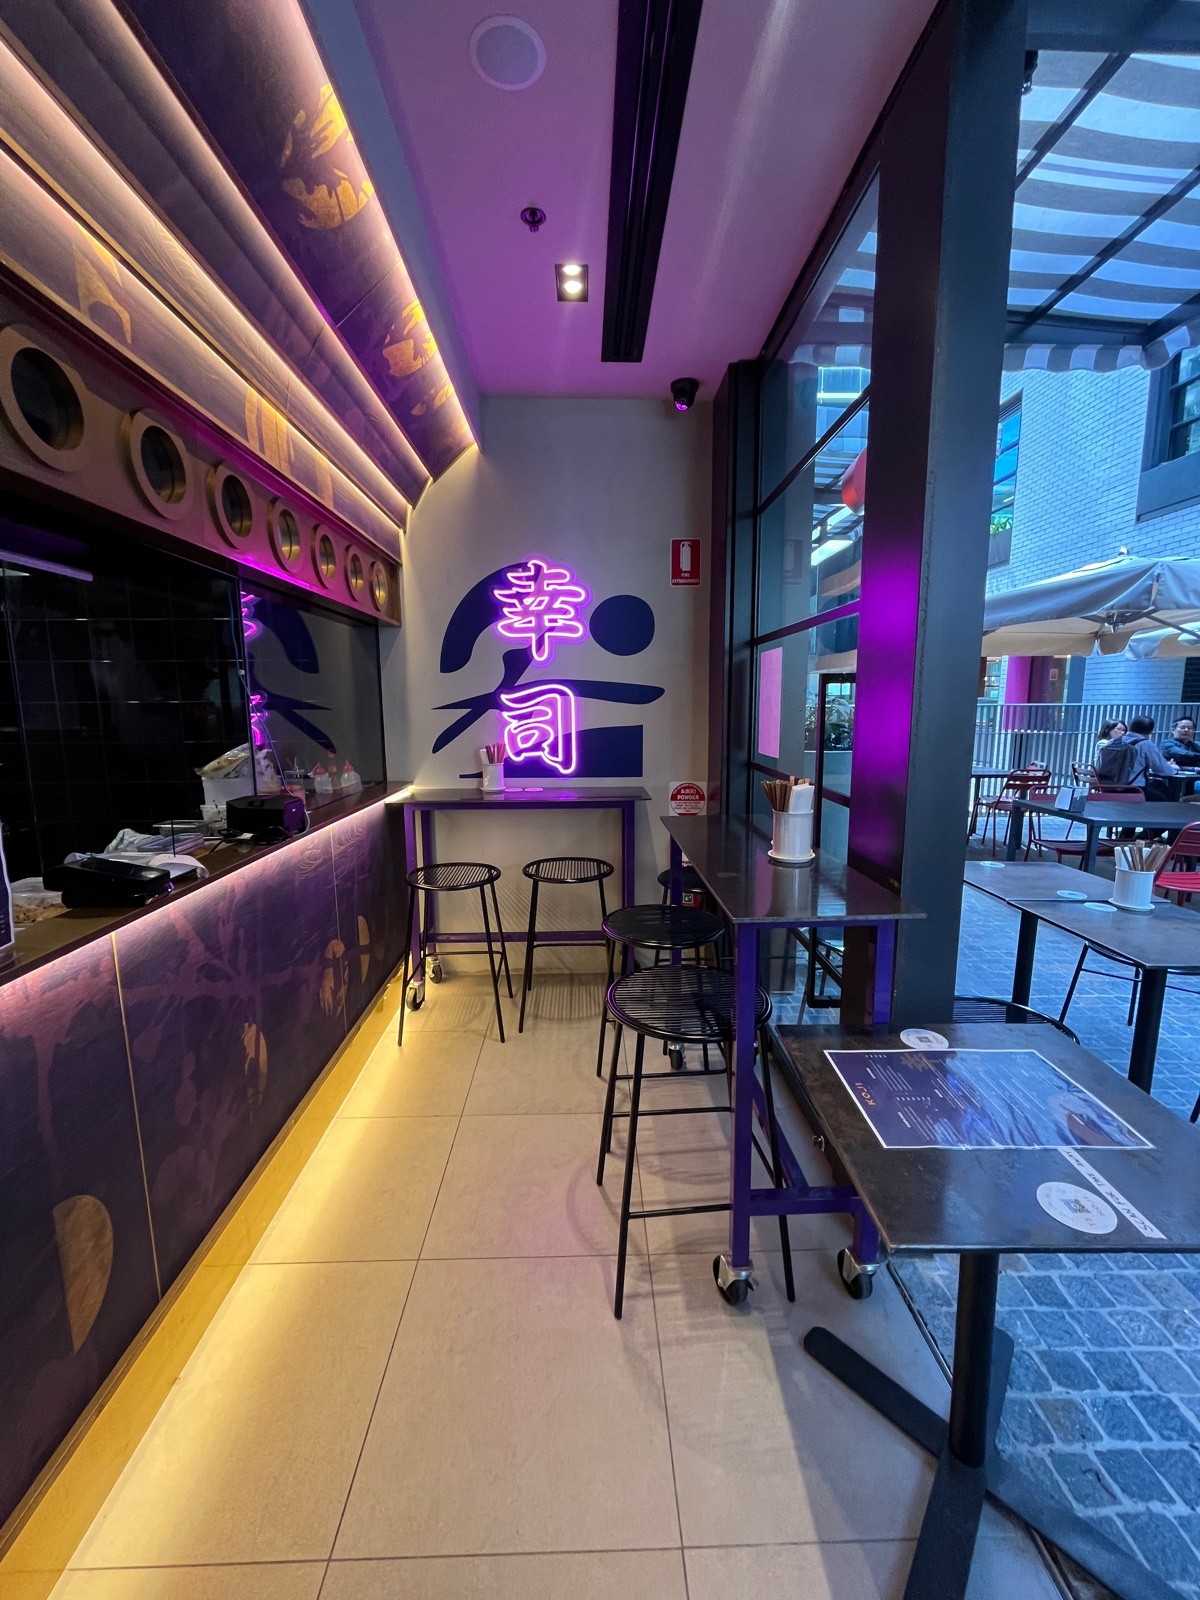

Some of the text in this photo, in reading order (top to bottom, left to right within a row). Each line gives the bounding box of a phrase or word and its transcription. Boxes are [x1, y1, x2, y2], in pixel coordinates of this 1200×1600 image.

[493, 560, 586, 774] 幸司
[855, 1082, 876, 1106] KOJI
[1105, 1190, 1126, 1206] FOR
[1121, 1207, 1154, 1233] SCAN
